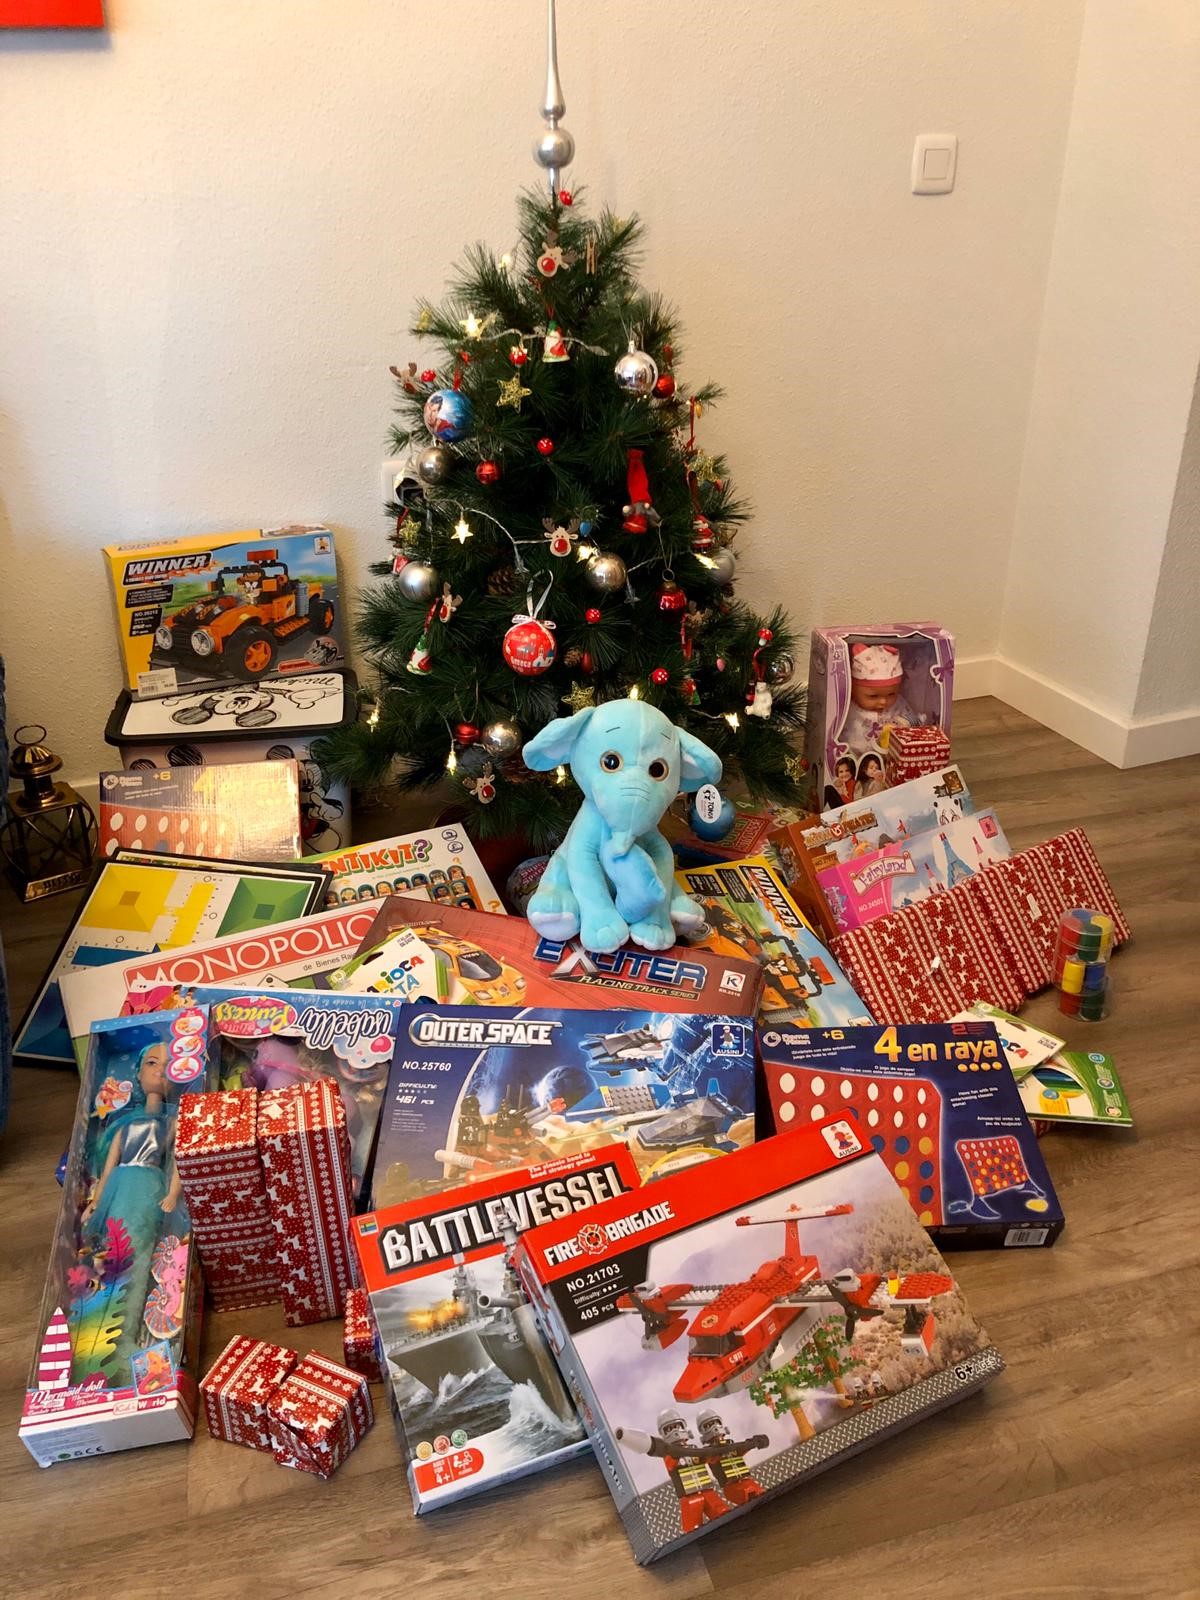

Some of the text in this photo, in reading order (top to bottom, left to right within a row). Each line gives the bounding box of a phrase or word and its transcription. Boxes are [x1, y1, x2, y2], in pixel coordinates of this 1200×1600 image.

[127, 555, 207, 575] WINNER
[750, 867, 801, 928] WINNER
[303, 963, 313, 971] de
[315, 956, 341, 969] Bienes
[578, 975, 633, 990] RACING
[633, 984, 671, 995] TRACK
[420, 1021, 553, 1046] OUTER SPACE
[822, 1029, 845, 1040] +6
[873, 1026, 999, 1063] 4 en raya
[401, 1060, 452, 1071] NO.25760
[543, 1200, 676, 1267] FIRE BRIGADE
[566, 1263, 621, 1293] NO.21703
[580, 1306, 600, 1321] 405
[954, 1364, 973, 1381] 6+
[31, 1384, 83, 1403] Mermaid
[85, 1379, 104, 1393] doll
[138, 1396, 167, 1410] Wrld
[436, 1472, 451, 1484] 4+
